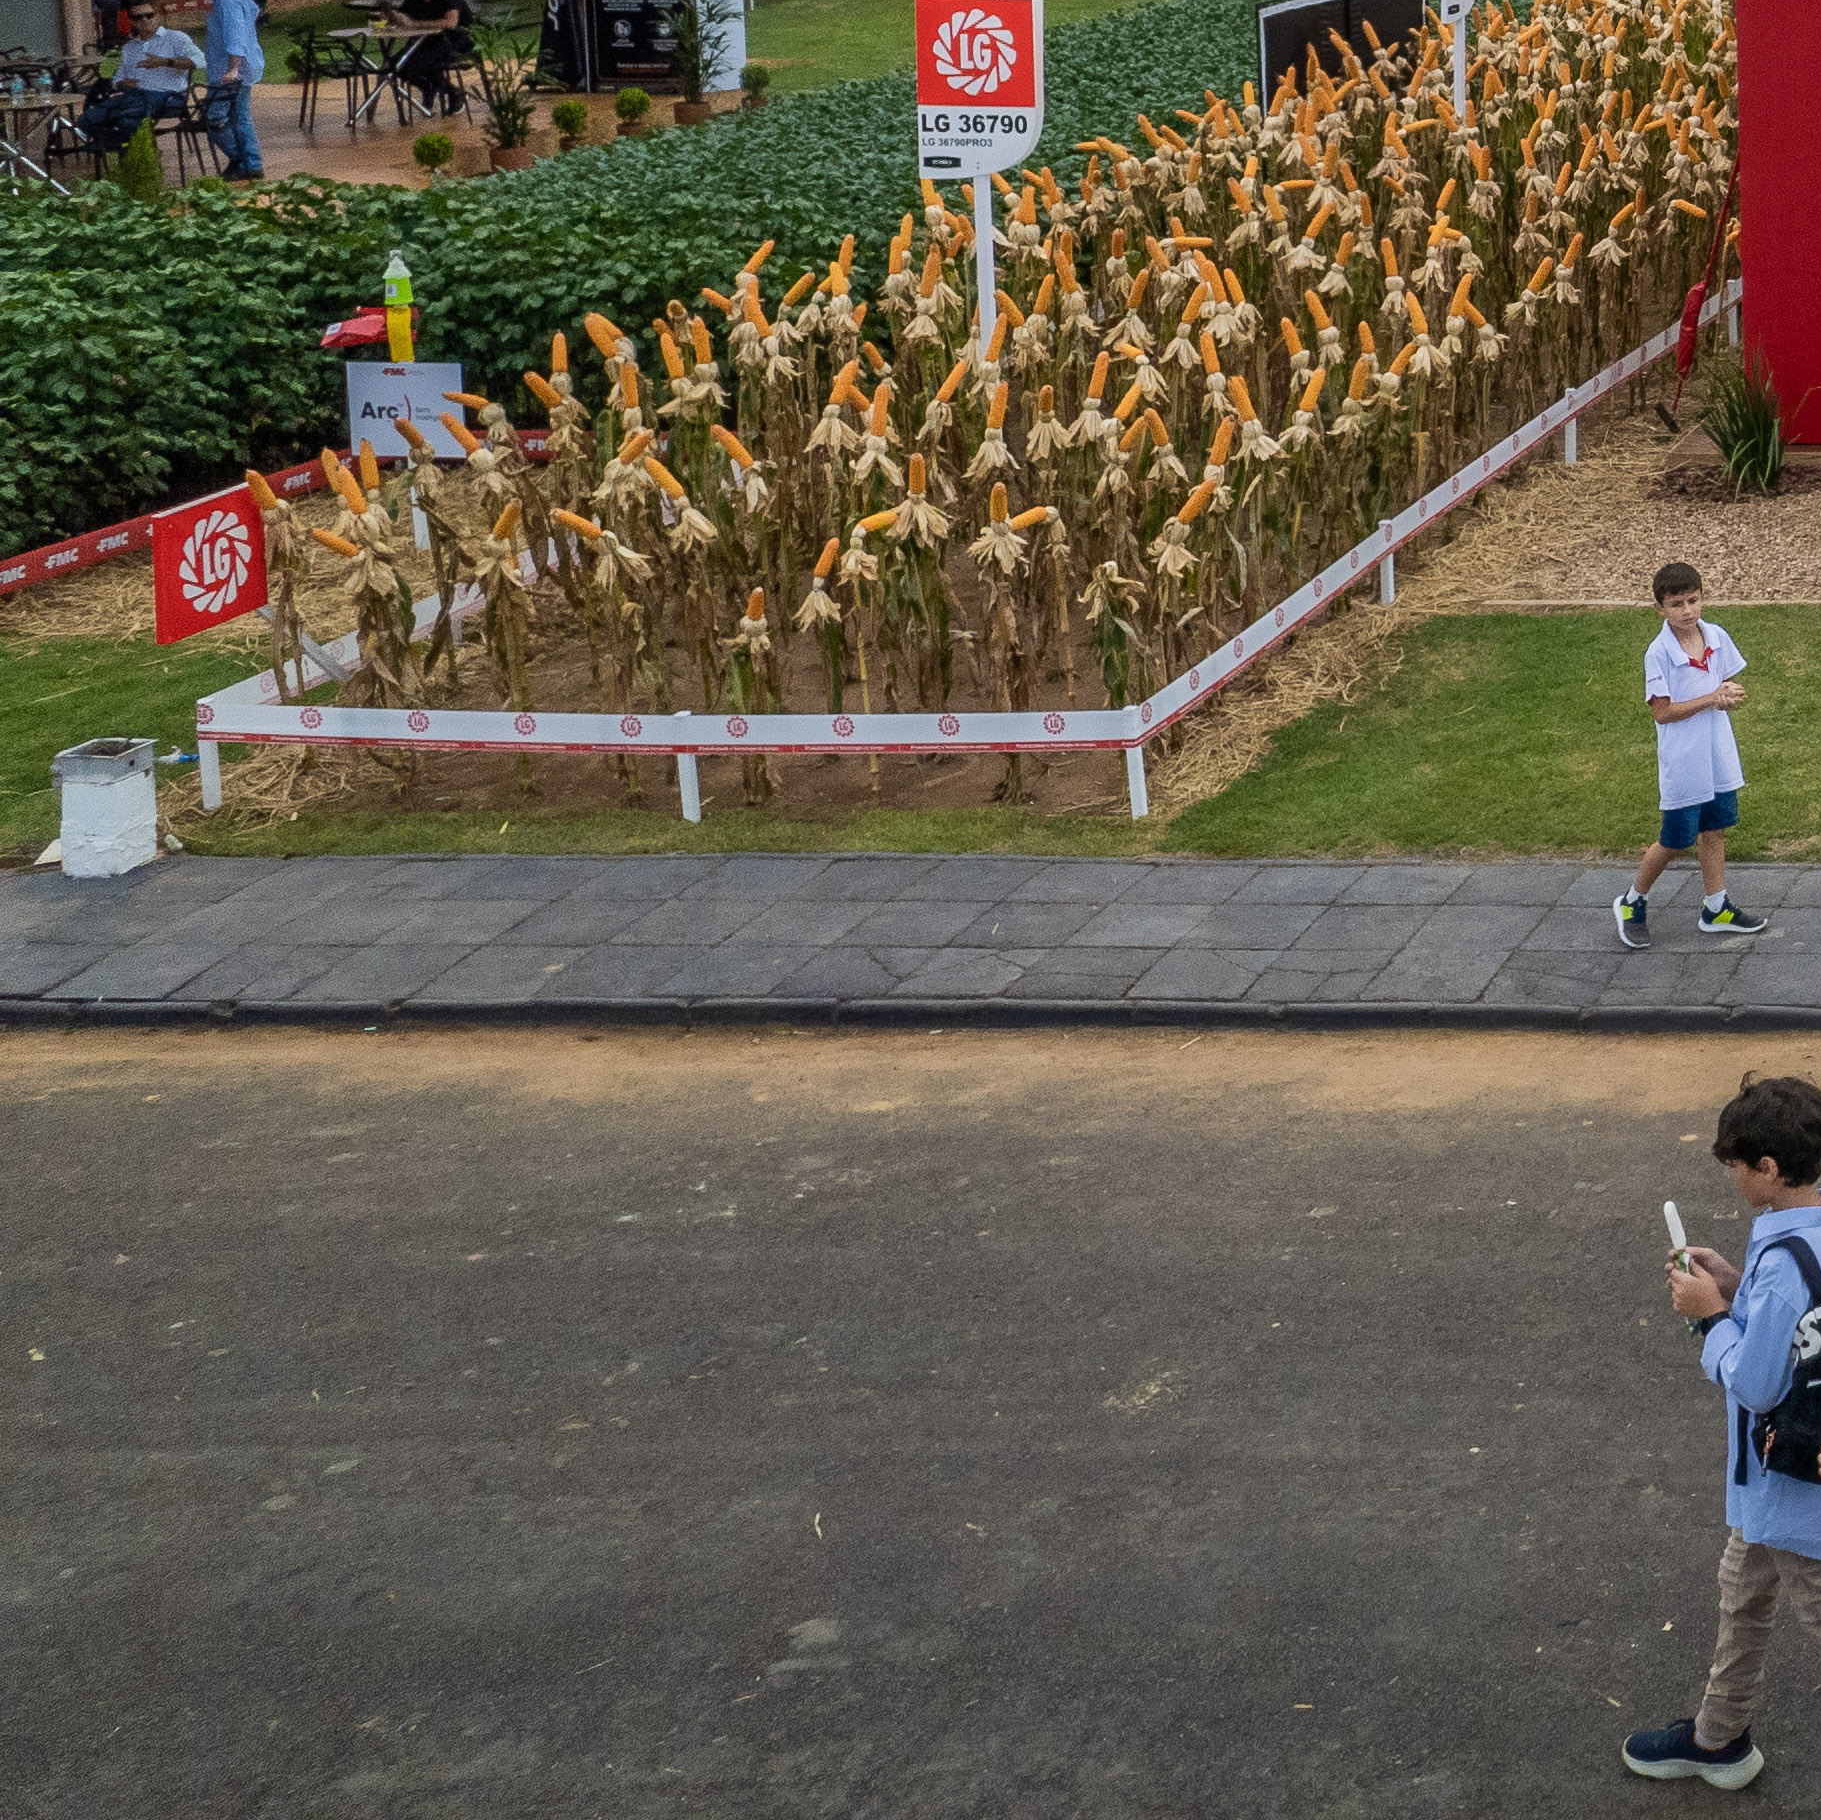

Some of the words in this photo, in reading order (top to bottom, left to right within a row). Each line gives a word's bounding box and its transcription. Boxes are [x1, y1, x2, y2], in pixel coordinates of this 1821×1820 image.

[959, 33, 992, 70] LG
[921, 114, 950, 133] LG
[958, 114, 1028, 134] 36790
[922, 138, 936, 146] LG
[938, 138, 993, 147] 36790PRO3
[360, 401, 399, 419] Arc
[45, 547, 79, 570] FMC
[96, 531, 129, 554] FMC
[202, 537, 231, 584] LG
